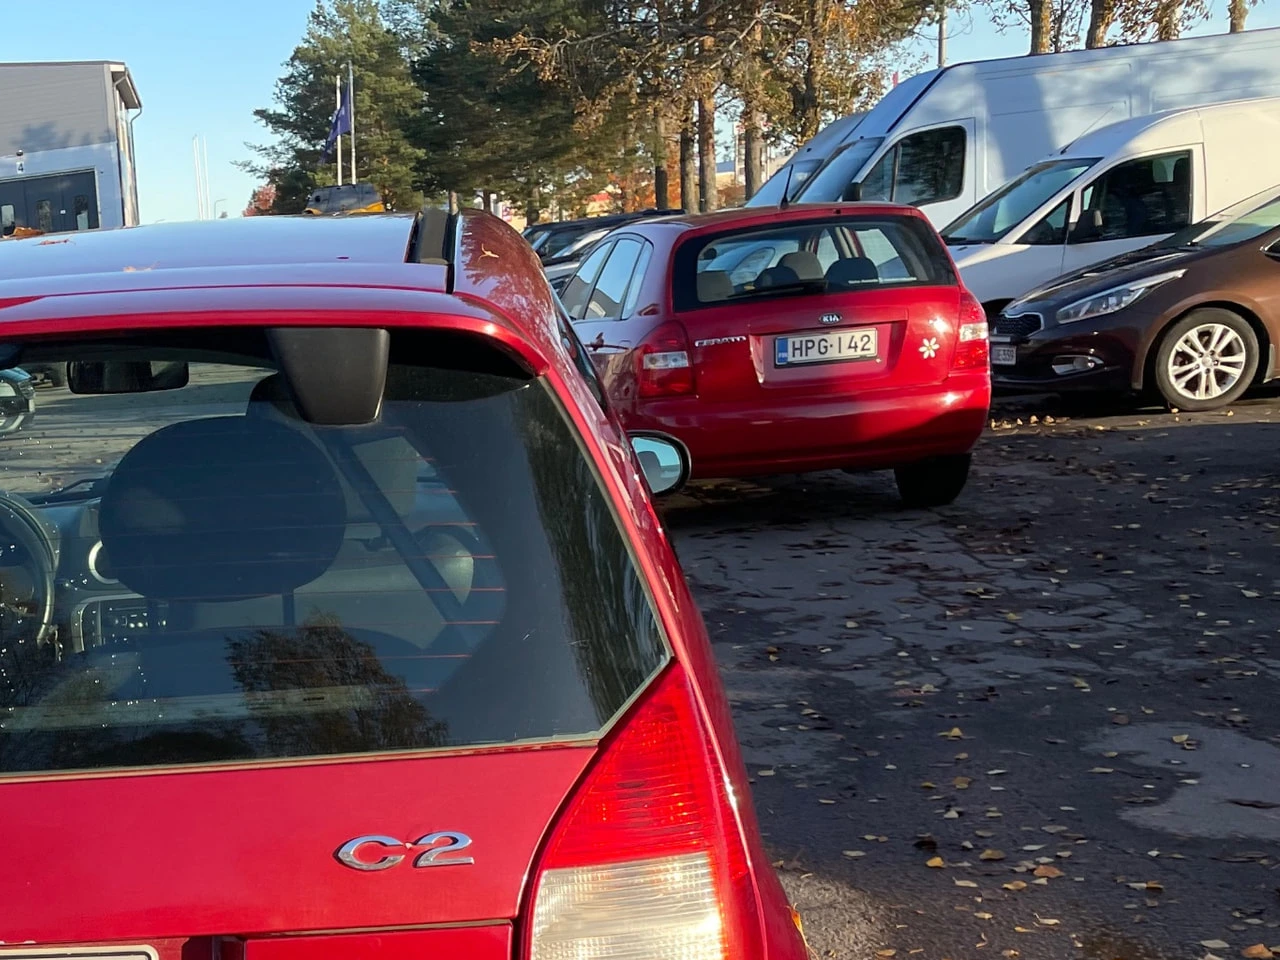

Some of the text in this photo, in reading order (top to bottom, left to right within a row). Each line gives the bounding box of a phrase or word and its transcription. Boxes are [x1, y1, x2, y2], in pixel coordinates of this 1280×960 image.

[17, 162, 24, 172] 4
[822, 315, 840, 323] KIA
[792, 334, 871, 358] HPG-142
